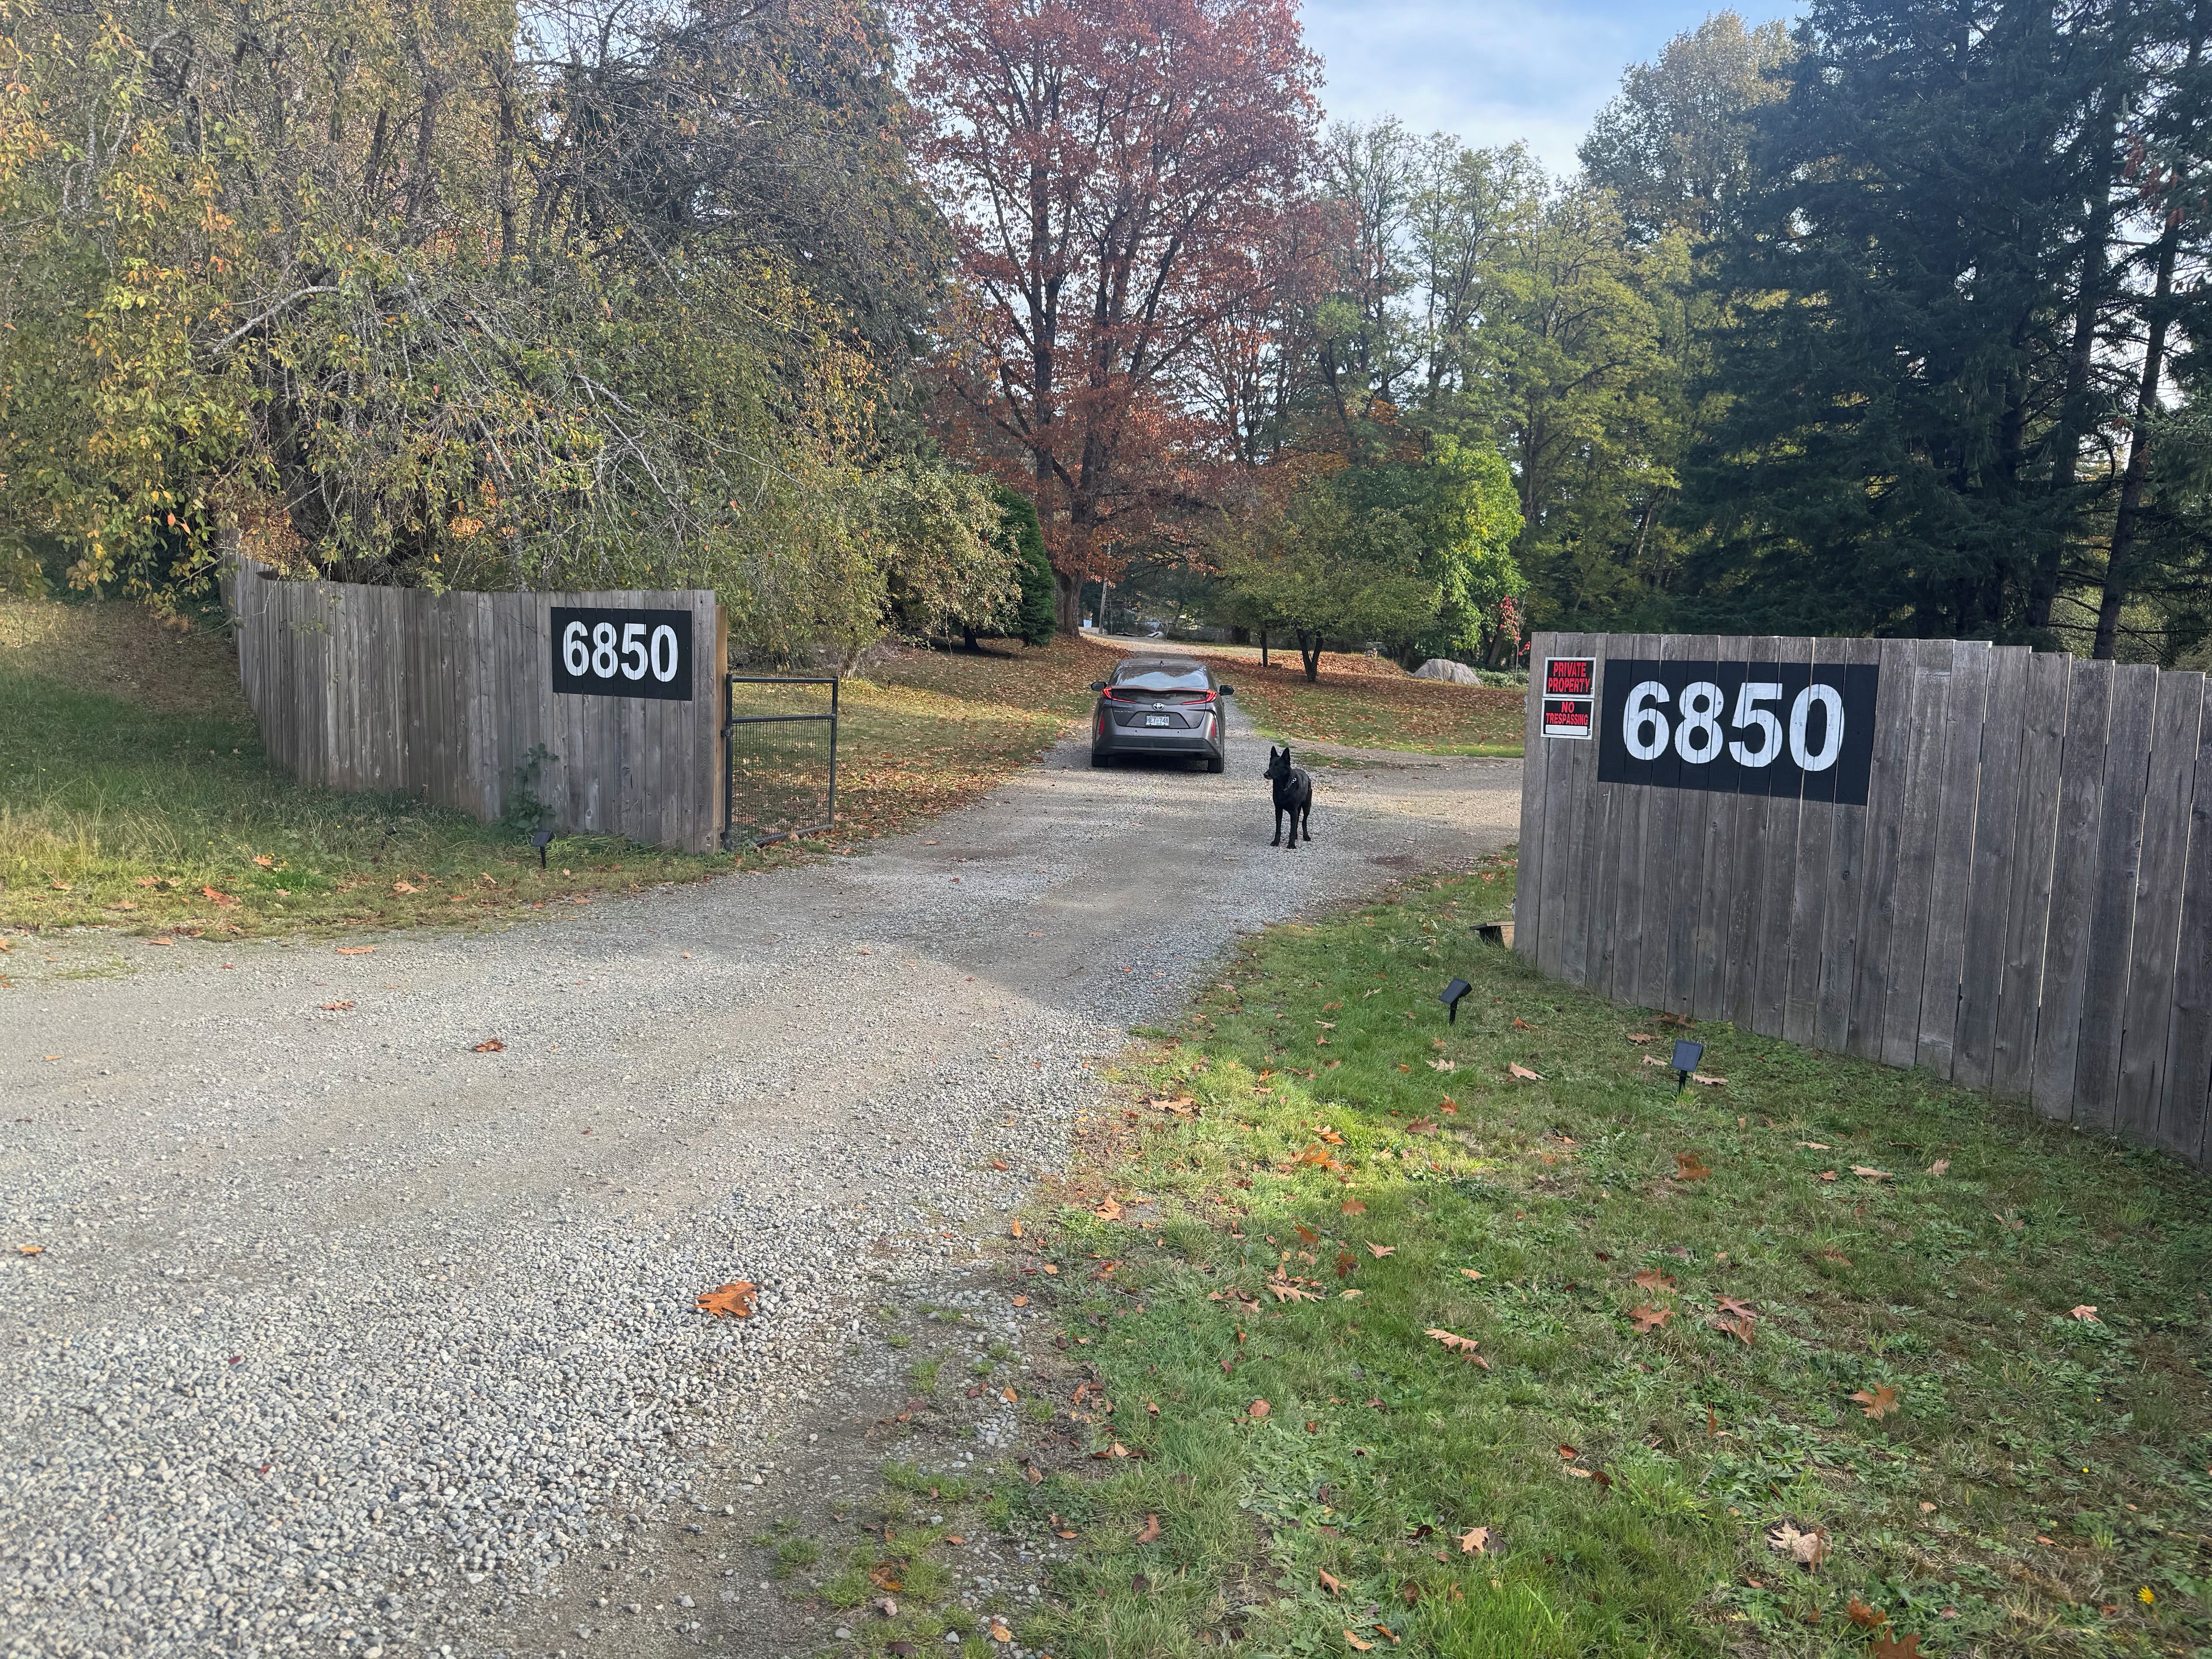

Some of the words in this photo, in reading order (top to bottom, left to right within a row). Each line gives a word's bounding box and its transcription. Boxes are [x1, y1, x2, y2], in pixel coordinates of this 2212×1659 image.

[563, 620, 679, 682] 6850
[1553, 662, 1586, 677] PRIVATE
[1548, 677, 1590, 692] PROPERTY
[1561, 702, 1574, 713] NO
[1546, 713, 1588, 725] TRESPASSING
[1623, 680, 1844, 771] 6850
